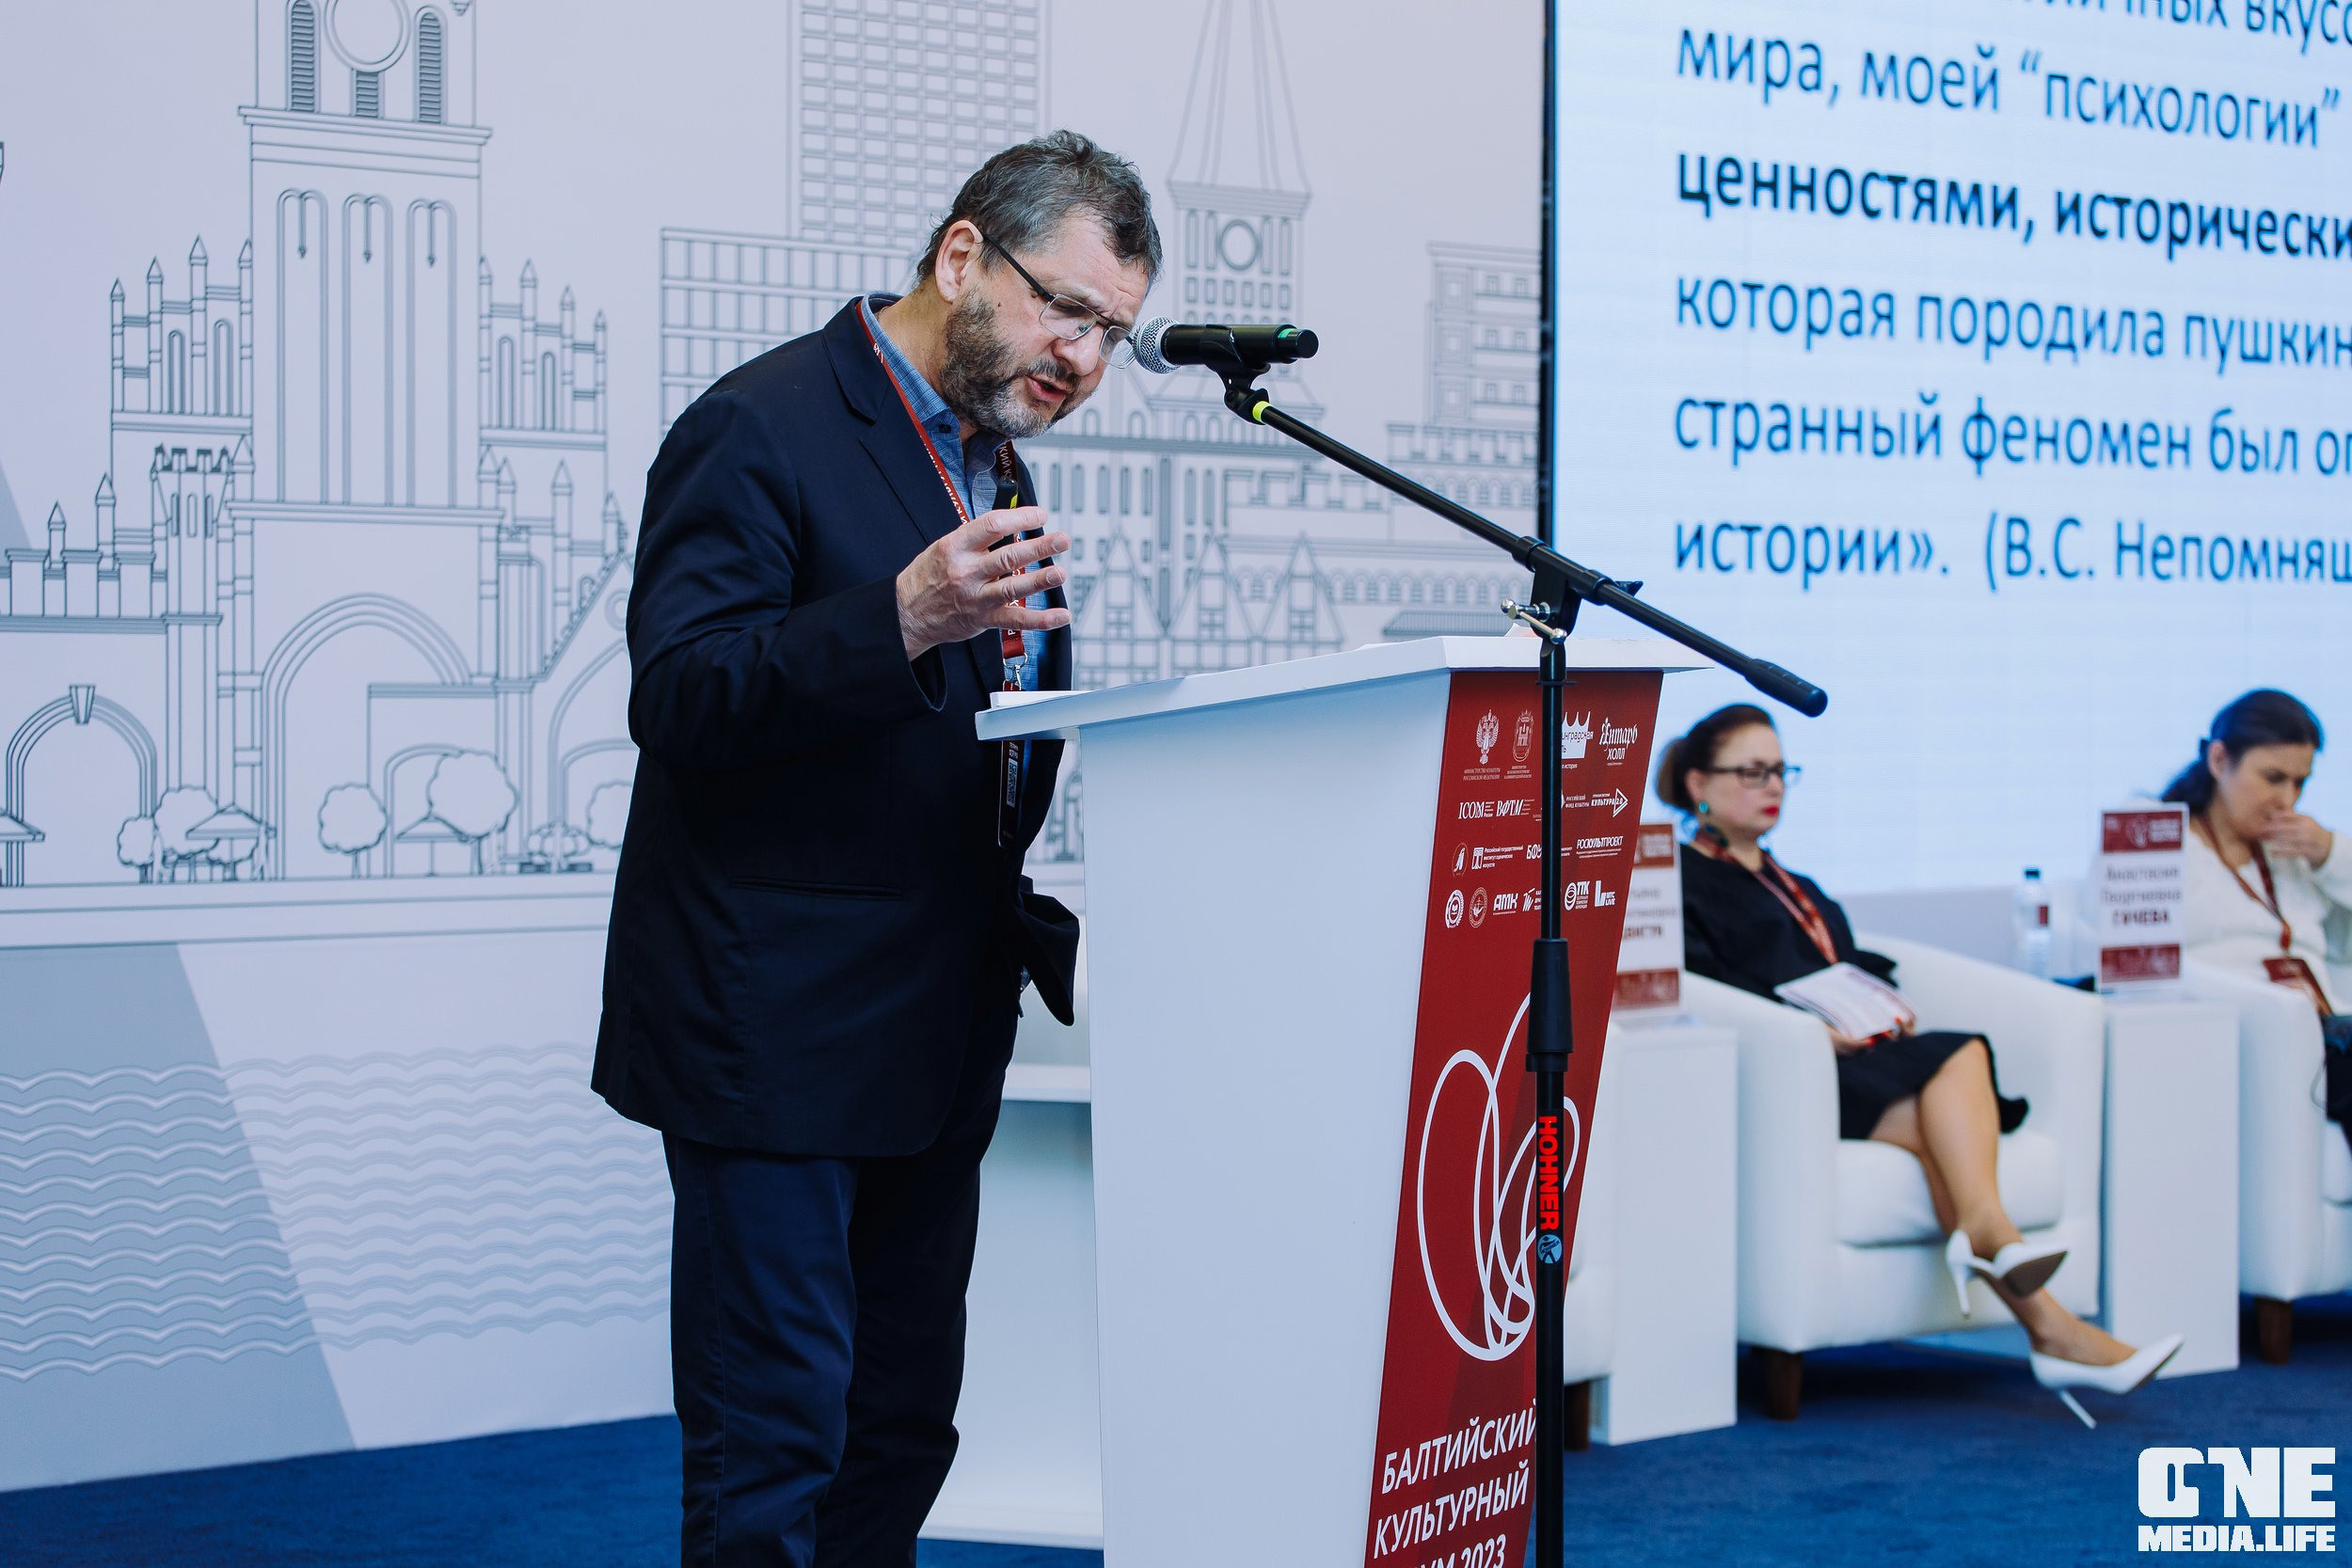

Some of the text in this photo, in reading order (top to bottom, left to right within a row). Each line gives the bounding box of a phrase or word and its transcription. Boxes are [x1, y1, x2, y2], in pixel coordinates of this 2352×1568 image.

[1677, 28, 1841, 106] мира,
[1860, 44, 2000, 112] моей
[1677, 152, 2036, 246] ценностями,
[1677, 277, 1897, 353] которая
[1916, 293, 2166, 364] породила
[1675, 391, 1944, 468] странный
[1961, 395, 2192, 479] феномен
[2207, 406, 2299, 475] был
[1675, 520, 1950, 594] истории».
[1984, 511, 2096, 594] (В.С.
[1538, 1116, 1560, 1230] HOHNER
[1381, 1398, 1536, 1495] БАЛТИЙСКИЙ
[1374, 1458, 1530, 1560] КУЛЬТУРНЫЙ
